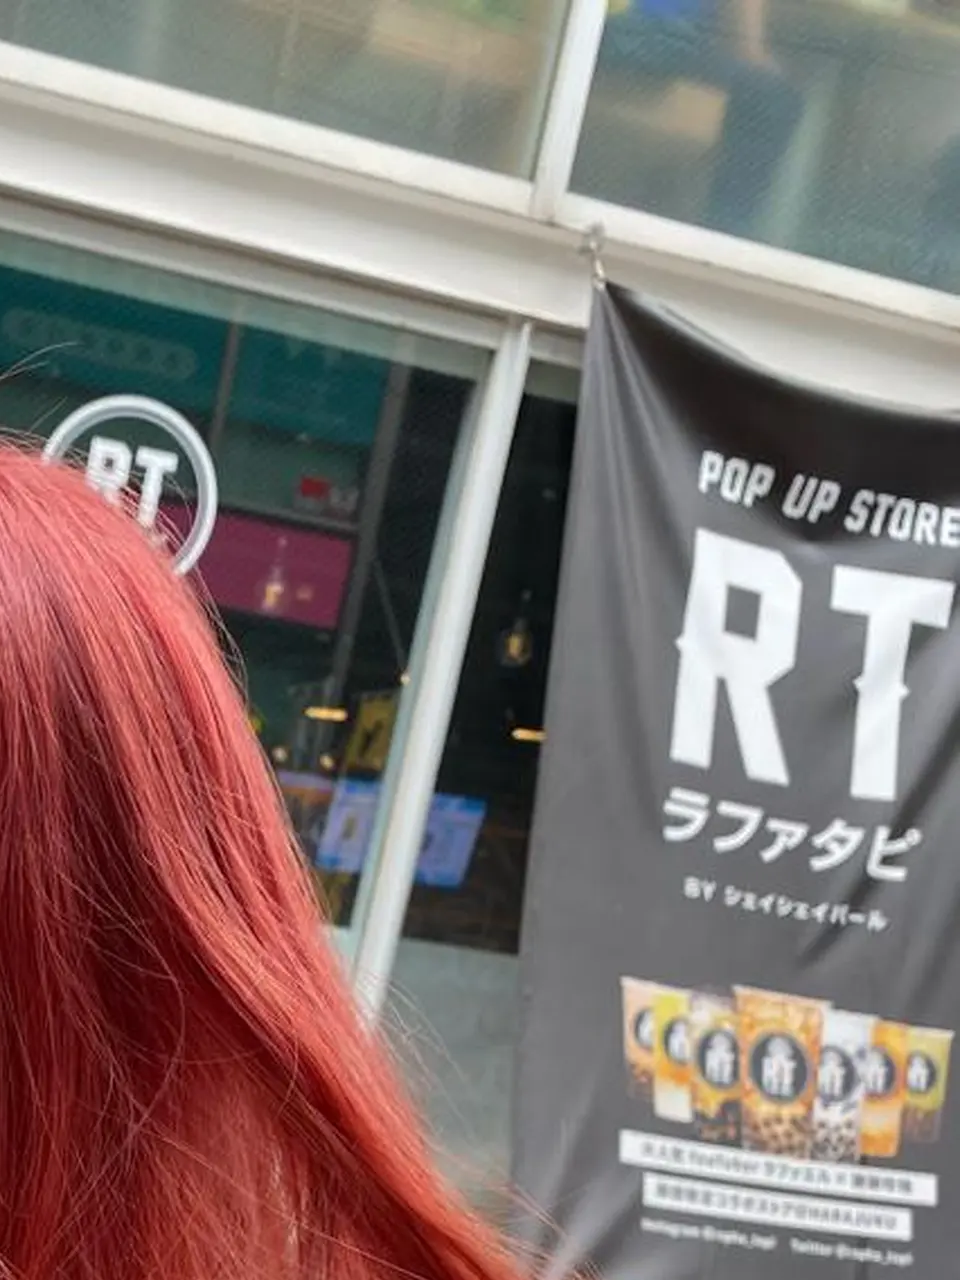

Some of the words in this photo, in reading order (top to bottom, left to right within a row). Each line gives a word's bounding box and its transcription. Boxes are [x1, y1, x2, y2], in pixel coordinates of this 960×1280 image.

[86, 435, 179, 529] RT
[698, 450, 775, 508] POP
[781, 473, 841, 523] UP
[843, 488, 960, 548] STORE
[669, 527, 955, 801] RT
[662, 786, 922, 881] ラファタピ
[684, 876, 717, 902] BY
